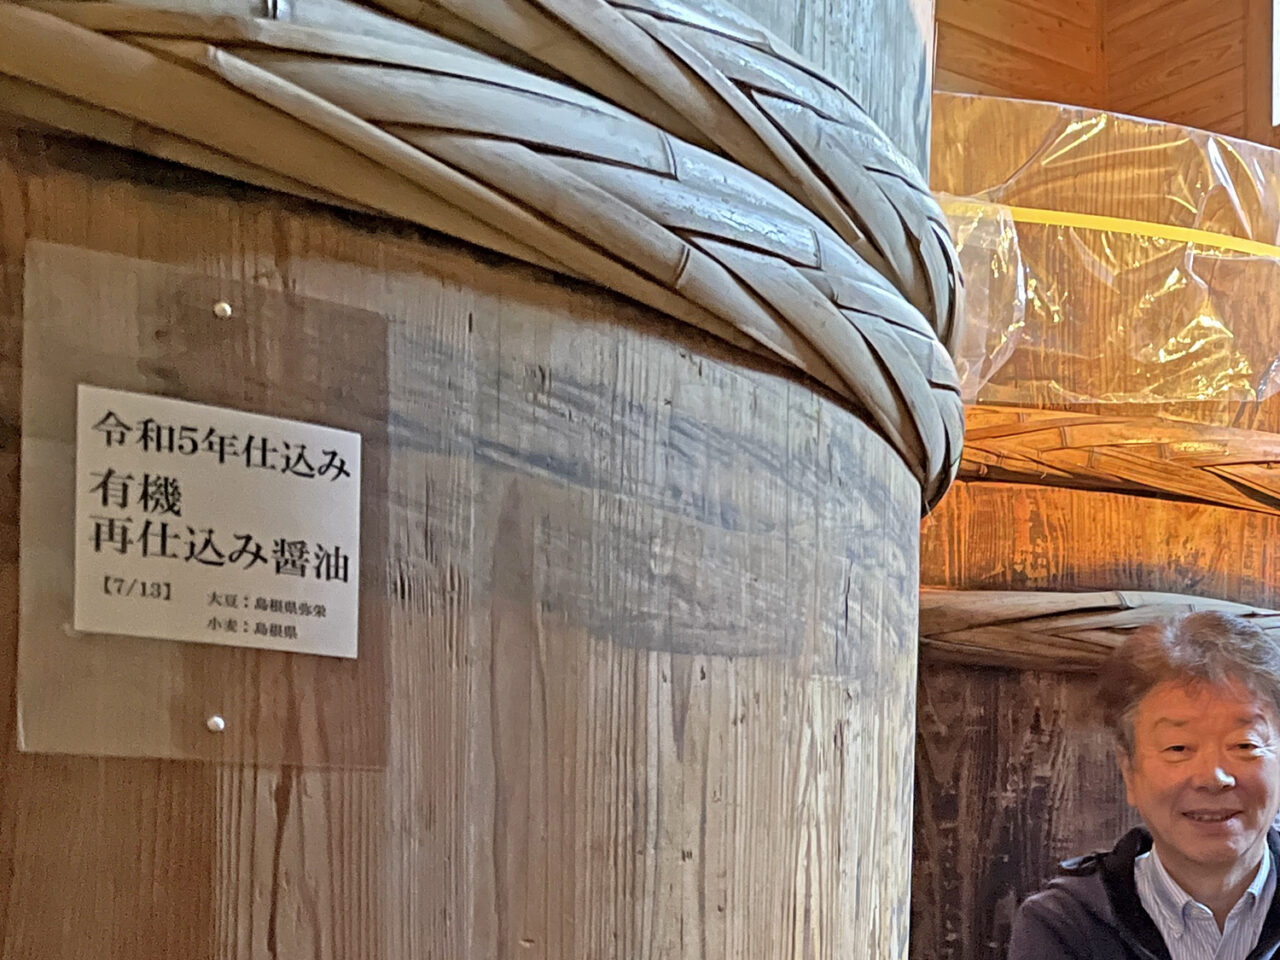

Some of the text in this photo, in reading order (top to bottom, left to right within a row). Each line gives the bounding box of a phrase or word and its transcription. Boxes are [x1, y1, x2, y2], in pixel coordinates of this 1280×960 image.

[91, 409, 351, 482] 令和5年仕込み
[89, 467, 182, 518] 有機
[87, 514, 350, 584] 再仕込み醤油
